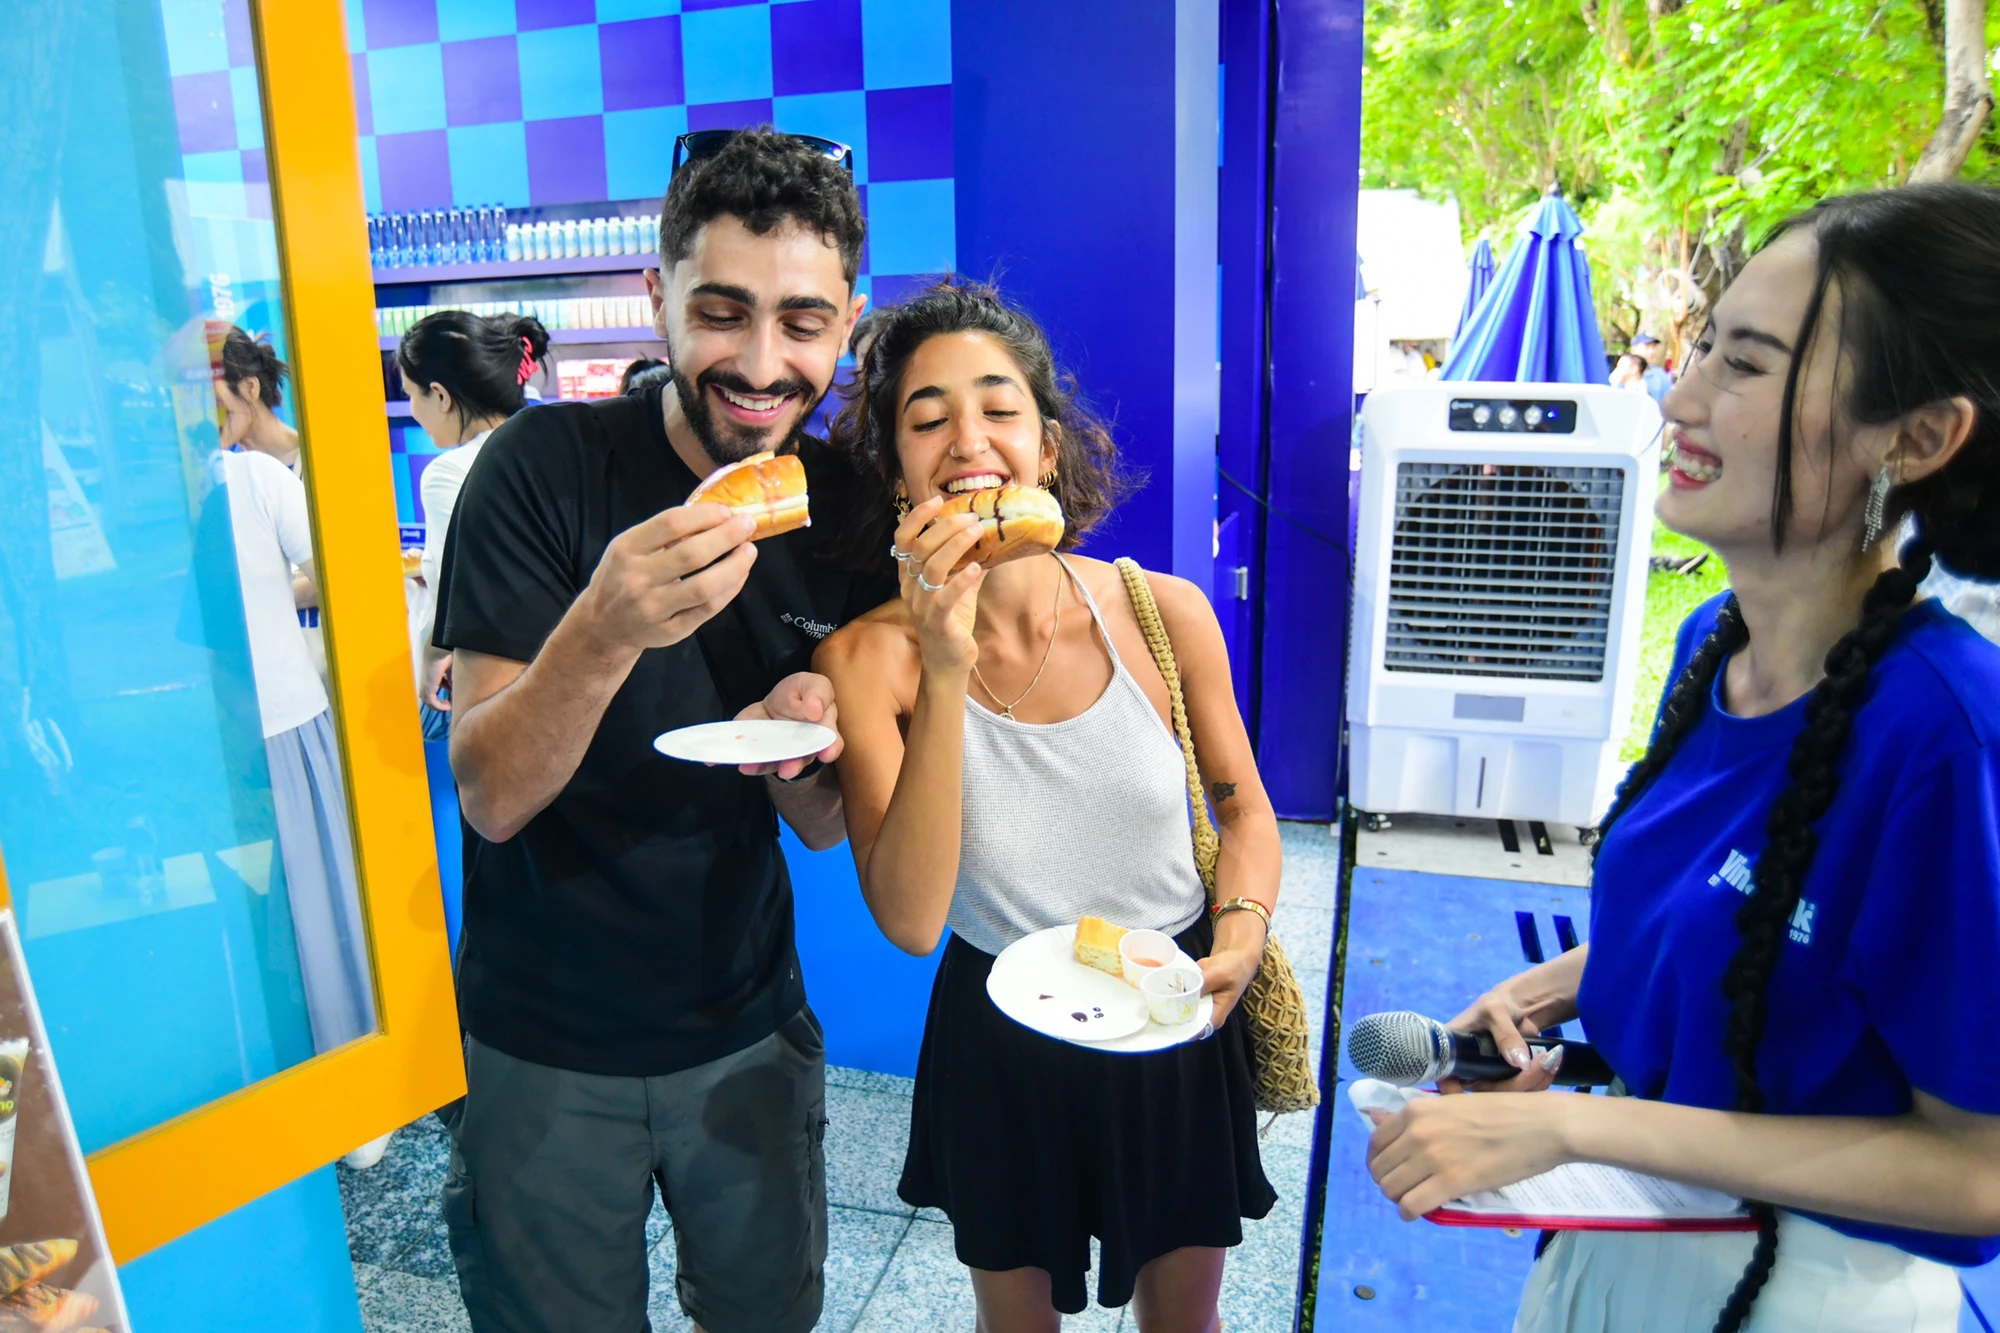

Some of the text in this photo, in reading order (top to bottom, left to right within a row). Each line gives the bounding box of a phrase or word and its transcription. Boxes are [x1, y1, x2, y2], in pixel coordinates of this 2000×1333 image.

[210, 272, 234, 319] 1976
[793, 616, 837, 633] Columbi
[1789, 928, 1810, 944] 1976
